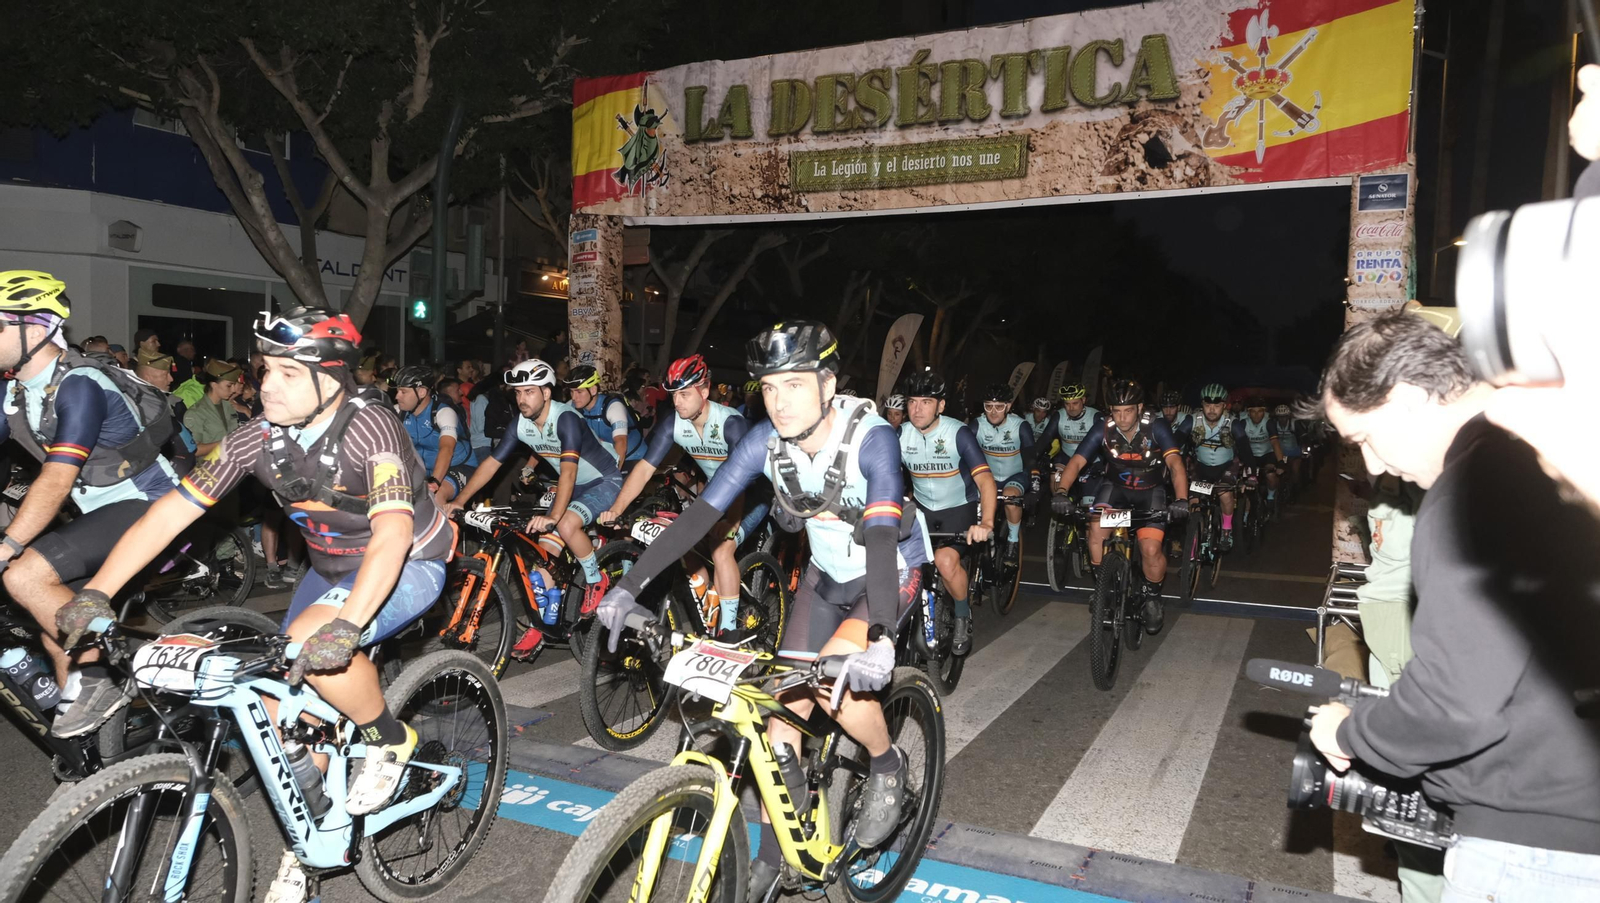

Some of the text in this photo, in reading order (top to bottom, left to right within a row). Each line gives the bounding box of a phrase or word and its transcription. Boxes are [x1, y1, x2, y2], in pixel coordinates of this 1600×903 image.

[684, 33, 1182, 141] LA DESÉRTICA
[813, 152, 1001, 178] La Legión y el desierto nos une
[1355, 222, 1404, 238] Coca-Cola
[1357, 250, 1401, 258] GRUPO
[1356, 258, 1402, 270] RENTA
[1356, 270, 1402, 284] TODO
[684, 652, 740, 681] 7804
[1269, 667, 1314, 687] RØDE
